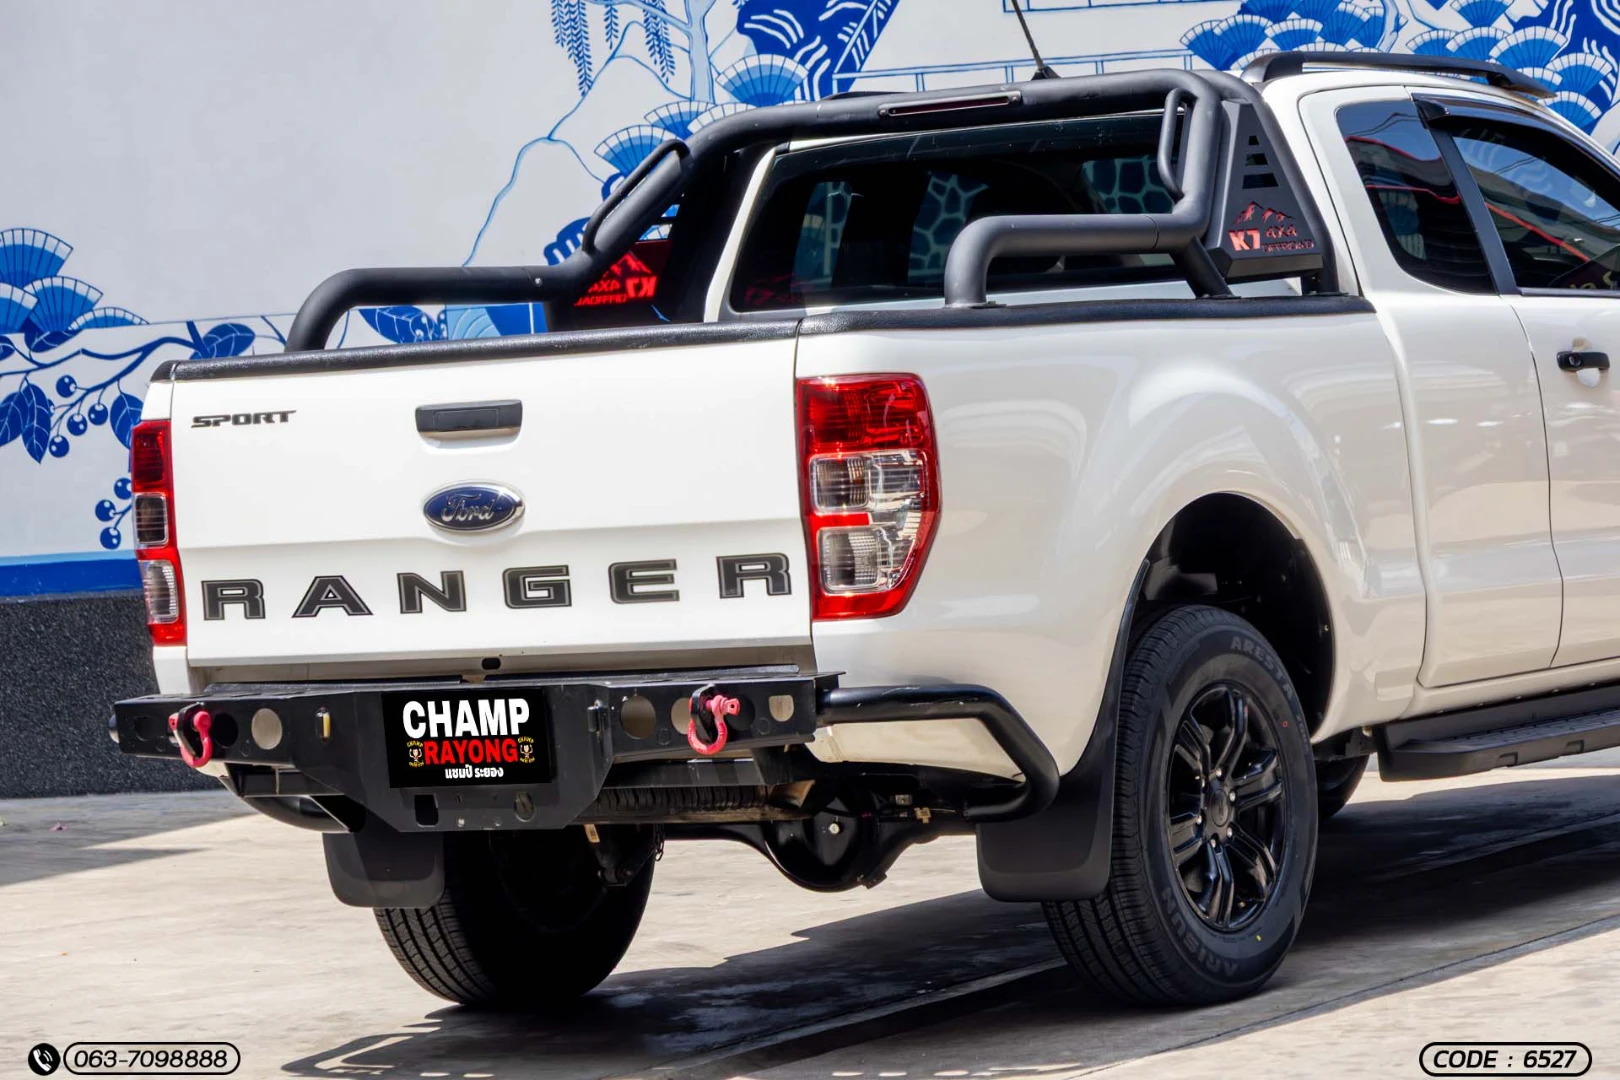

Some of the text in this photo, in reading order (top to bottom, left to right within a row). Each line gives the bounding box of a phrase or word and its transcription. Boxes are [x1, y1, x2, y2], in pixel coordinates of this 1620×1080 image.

[1228, 227, 1260, 251] K7
[190, 410, 296, 428] SPORT
[441, 493, 495, 522] Ford
[201, 552, 792, 620] RANGER
